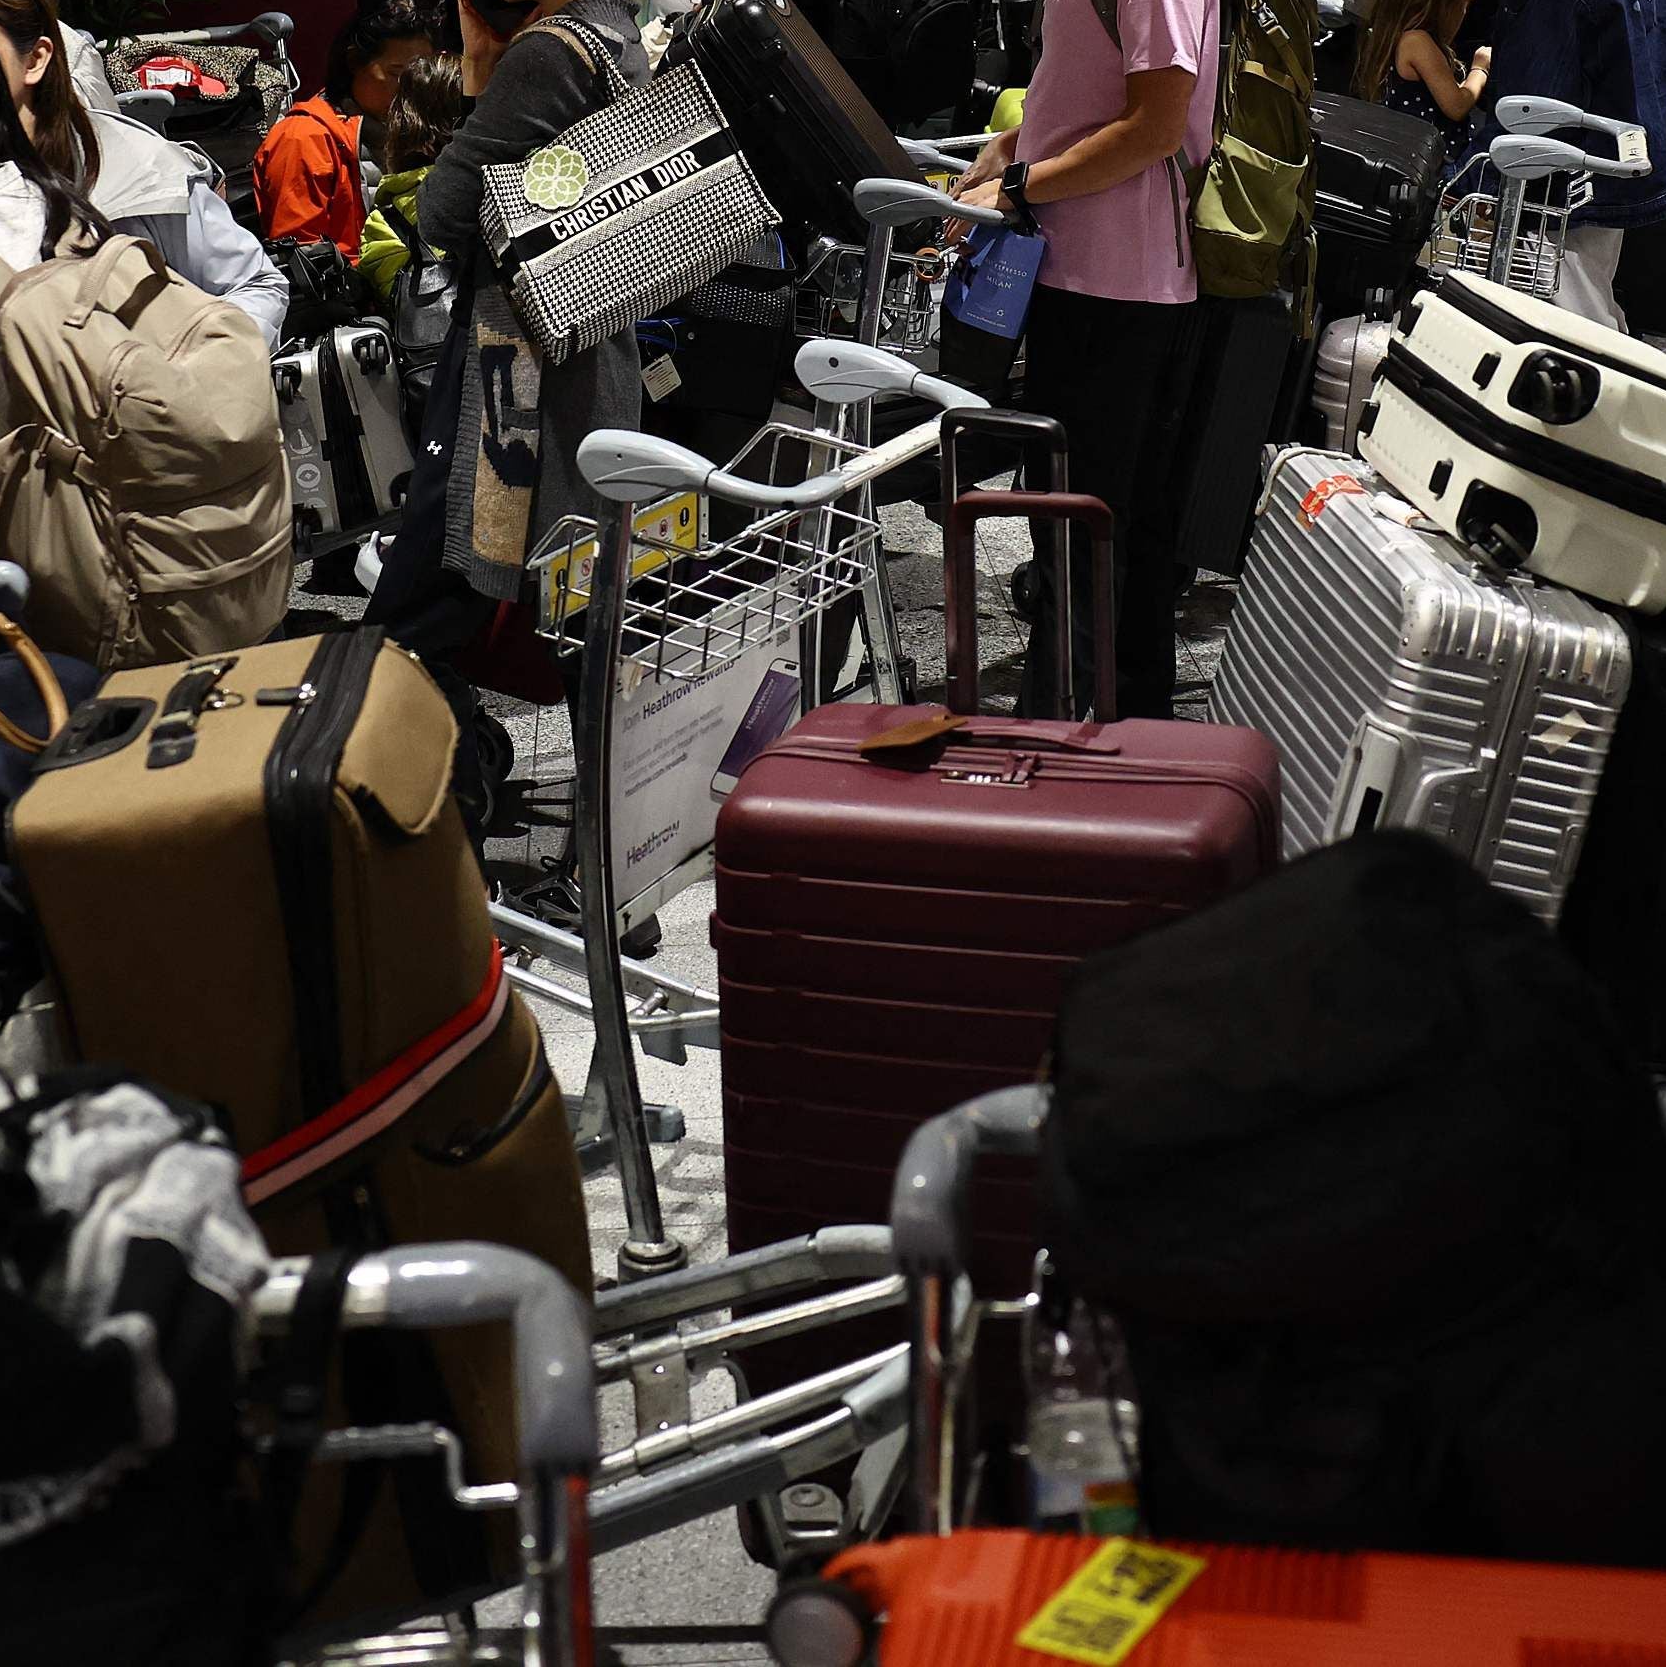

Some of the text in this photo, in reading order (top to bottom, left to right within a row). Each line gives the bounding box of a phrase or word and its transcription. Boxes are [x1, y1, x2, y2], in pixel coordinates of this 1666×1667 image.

[549, 150, 703, 241] CHRISTIAN DIOR
[643, 683, 692, 719] Heathrow
[626, 820, 680, 869] Heathrow
